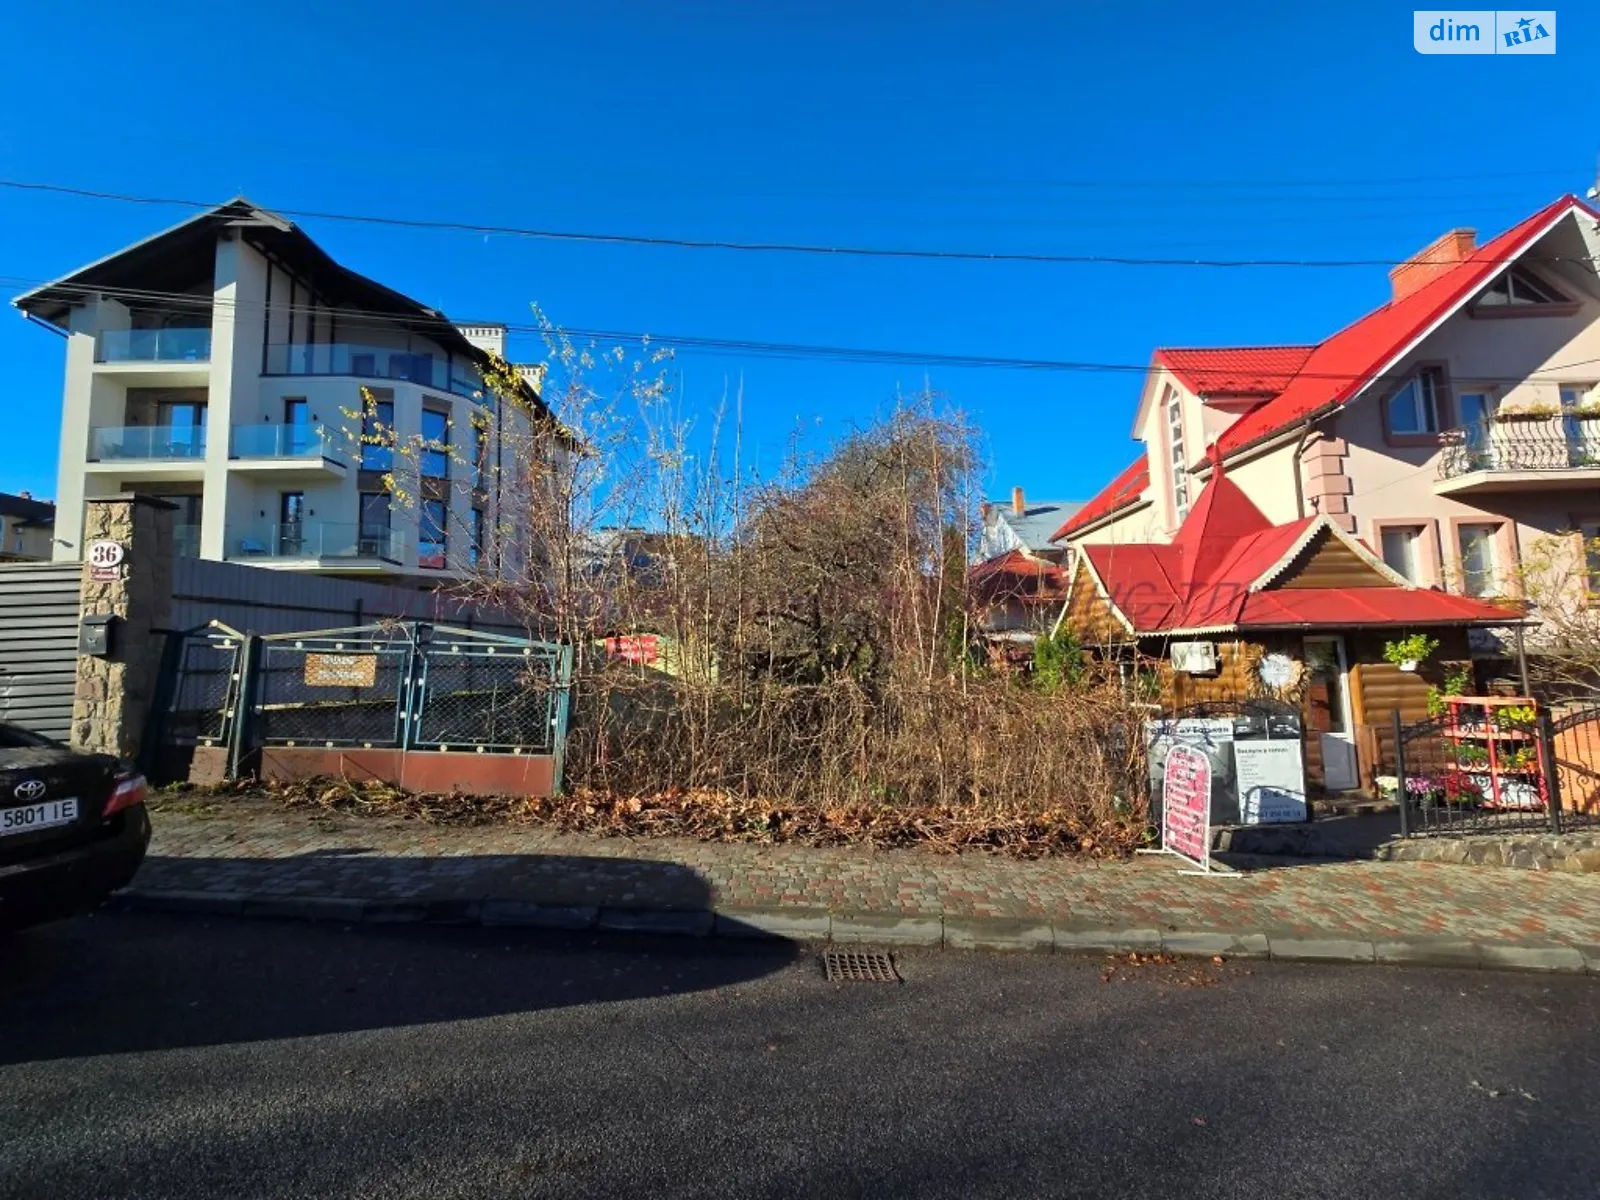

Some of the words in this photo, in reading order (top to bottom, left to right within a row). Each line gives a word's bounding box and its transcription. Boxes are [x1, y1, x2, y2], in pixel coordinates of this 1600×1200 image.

[93, 545, 117, 563] 36
[3, 805, 46, 828] 5801
[53, 800, 75, 819] IE
